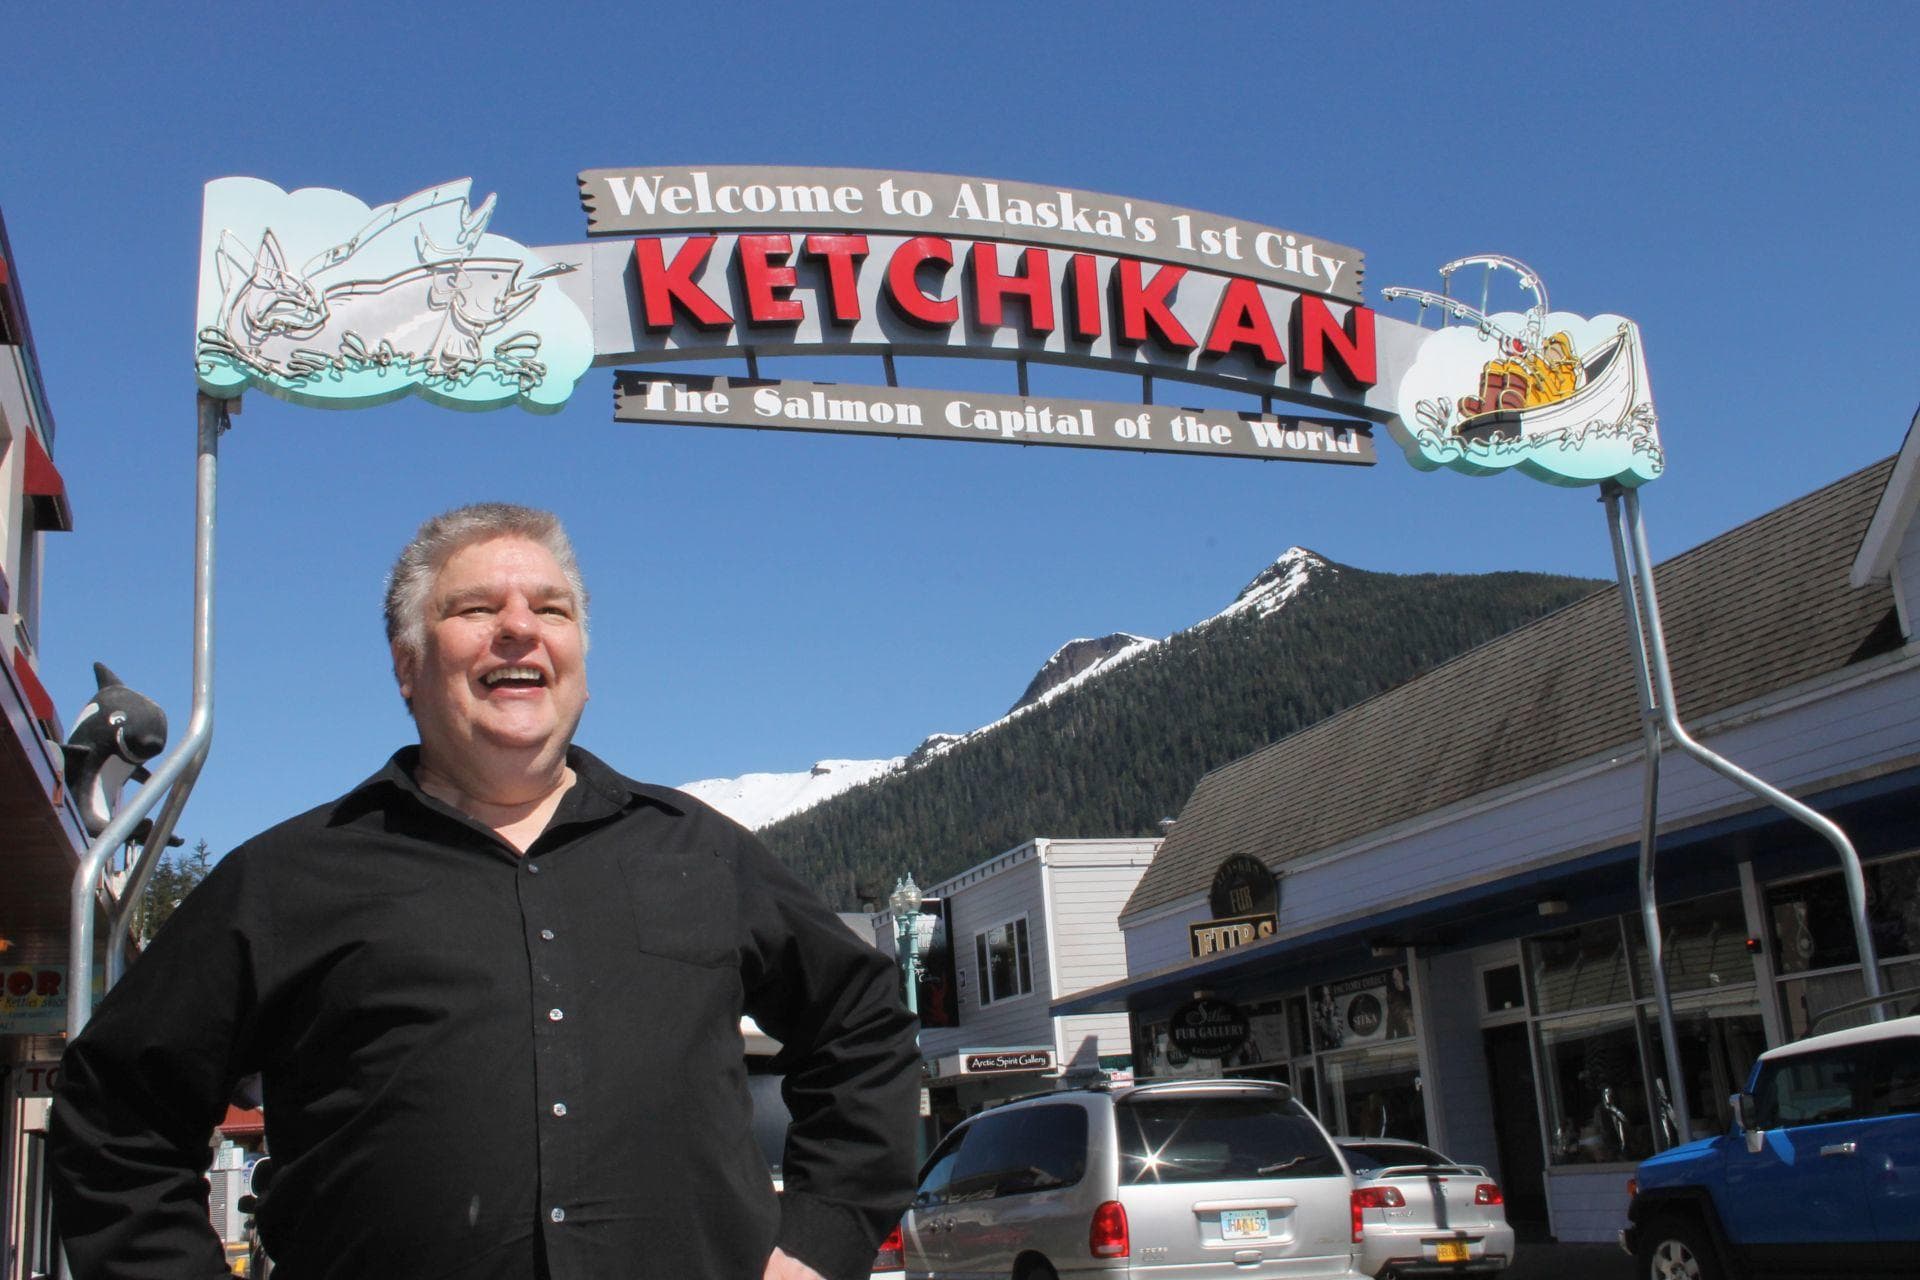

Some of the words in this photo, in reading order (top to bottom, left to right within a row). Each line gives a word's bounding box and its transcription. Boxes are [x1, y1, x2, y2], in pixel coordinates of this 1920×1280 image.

[604, 171, 863, 216] Welcome
[876, 177, 934, 217] to
[948, 182, 1157, 242] Alaska's
[1171, 214, 1244, 261] 1st
[1254, 231, 1346, 294] City
[632, 233, 1378, 387] KETCHIKAN
[637, 380, 730, 416] The
[752, 388, 923, 427] Salmon
[944, 400, 1096, 438] Capital
[1114, 412, 1152, 441] of
[1169, 413, 1233, 446] the
[1247, 420, 1361, 455] World
[1229, 885, 1255, 914] FUR
[1175, 1027, 1197, 1040] FUR
[1198, 1024, 1245, 1039] GALLERY
[971, 1058, 995, 1068] Arctic
[996, 1056, 1018, 1068] Spirit
[1019, 1054, 1046, 1066] Gallery
